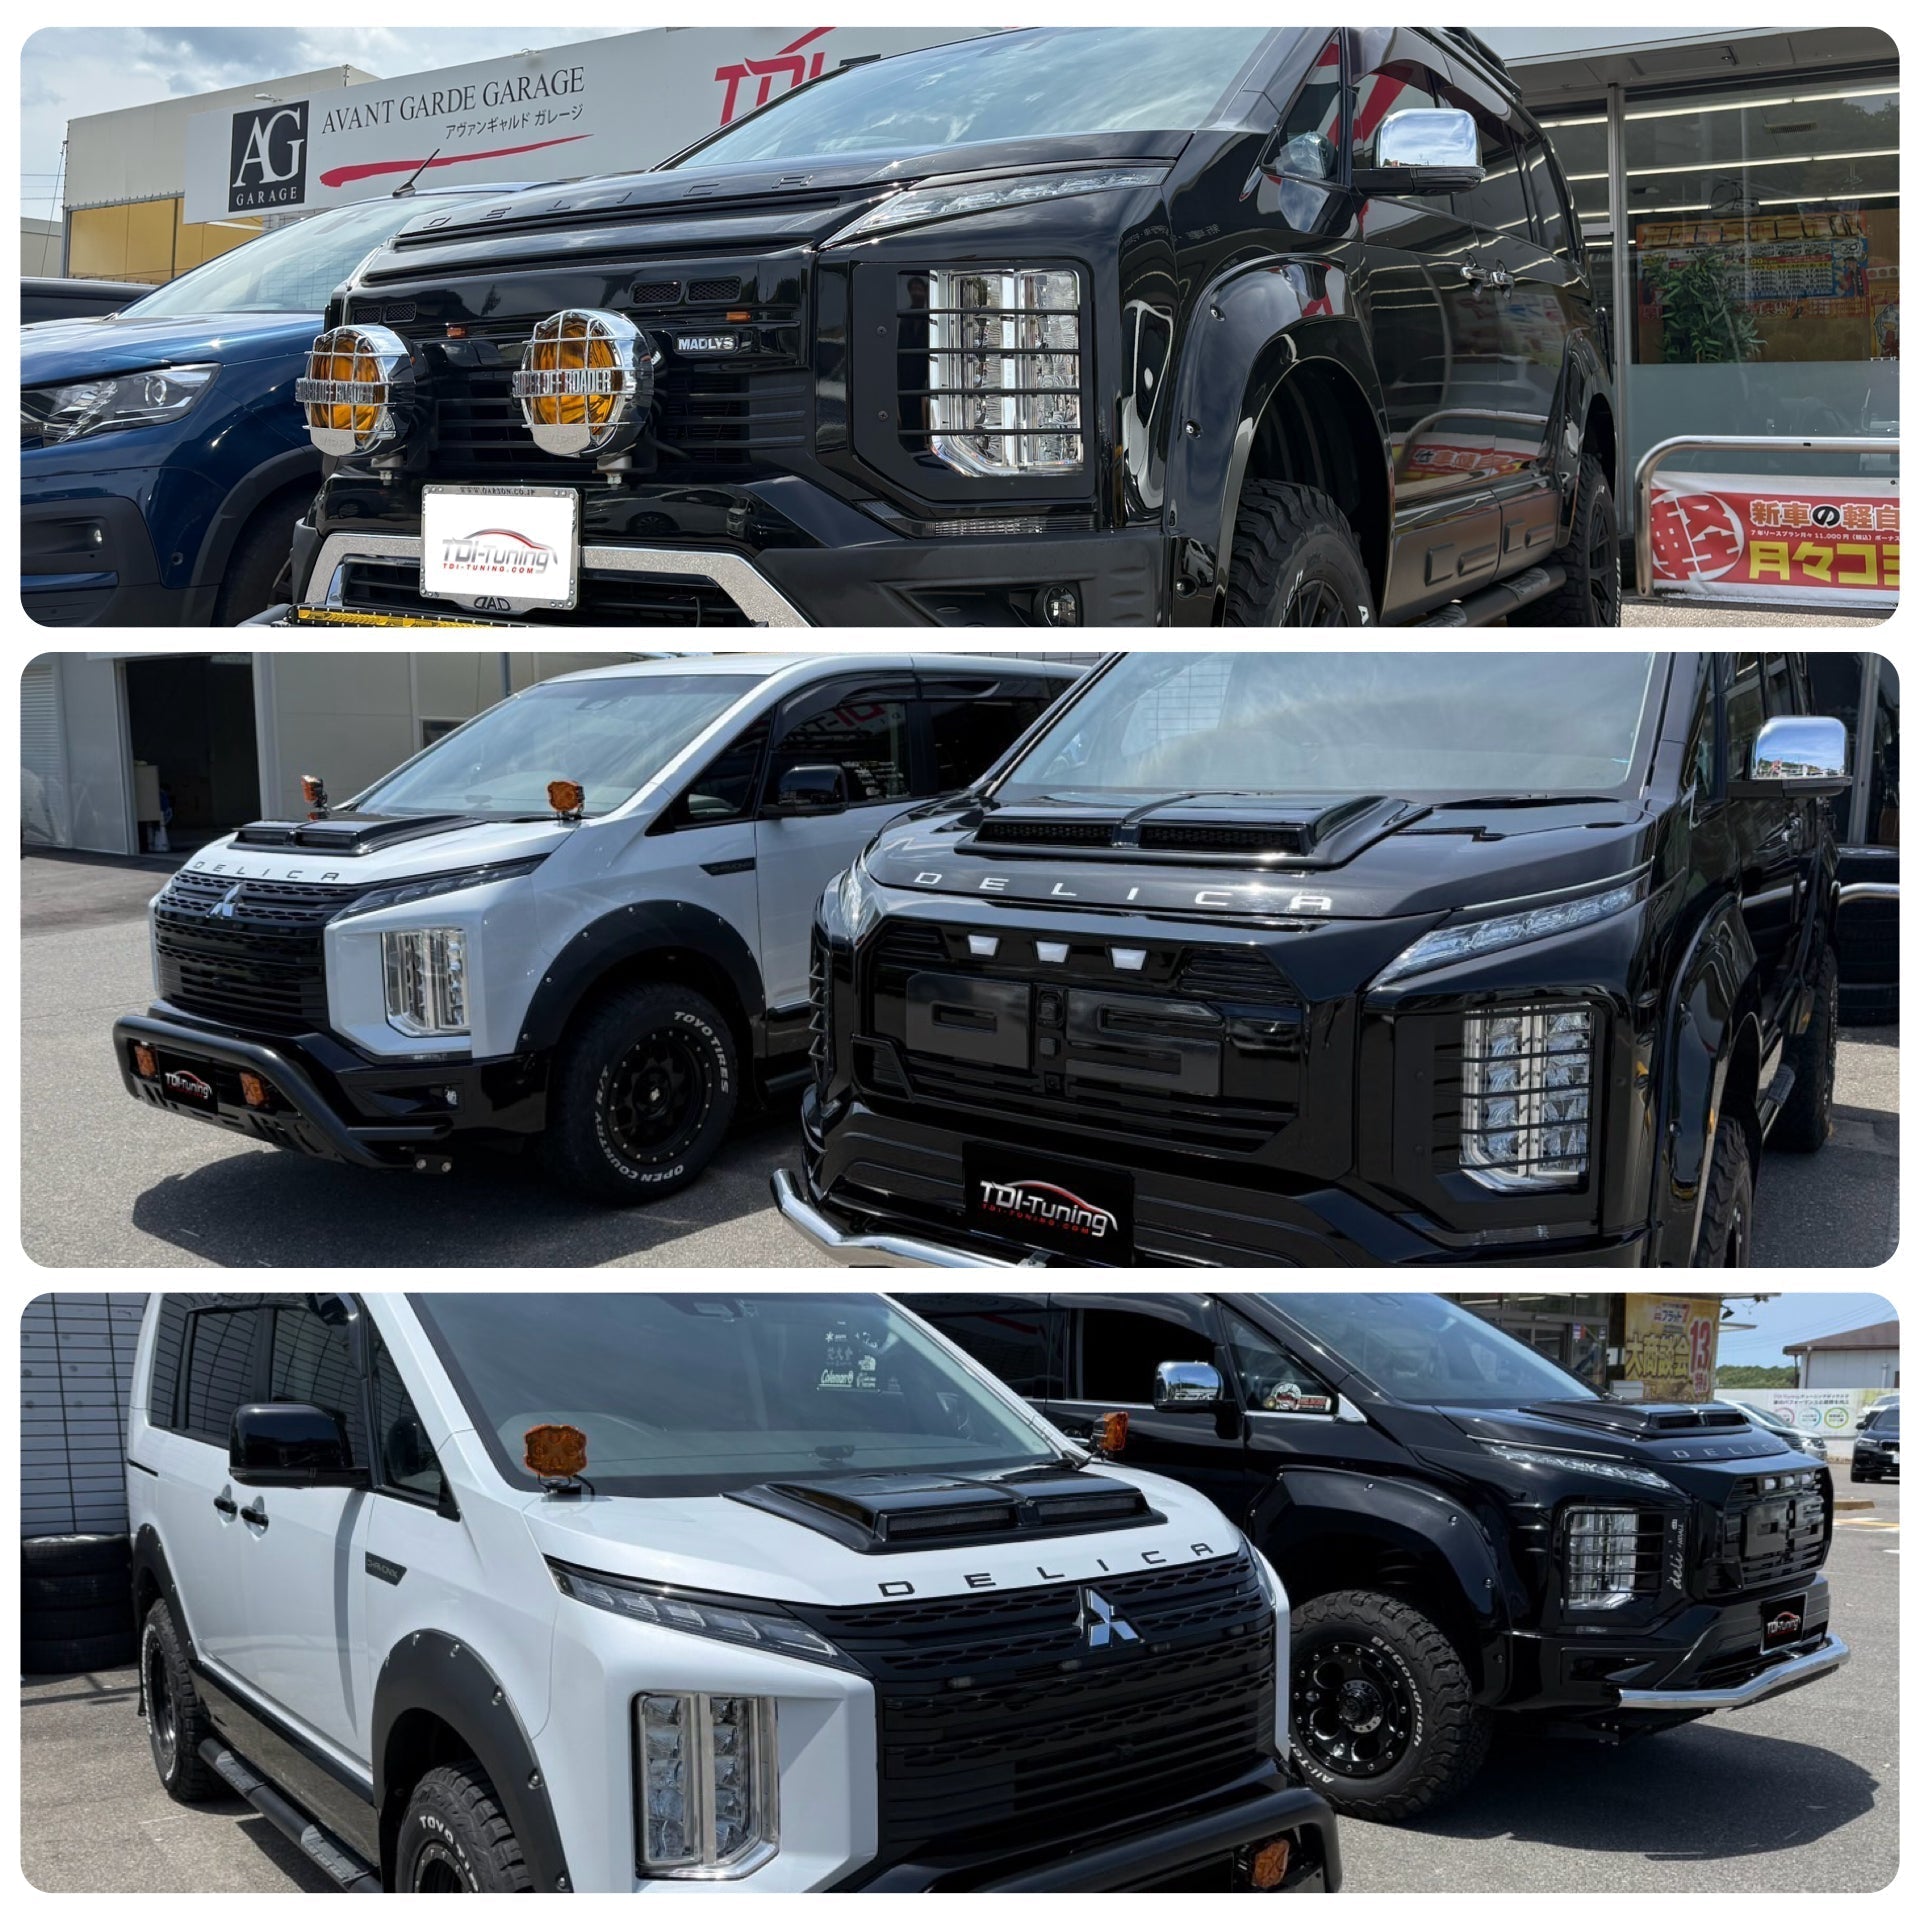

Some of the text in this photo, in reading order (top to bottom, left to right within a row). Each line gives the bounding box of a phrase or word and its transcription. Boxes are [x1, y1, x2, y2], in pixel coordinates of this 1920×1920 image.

[321, 66, 586, 134] AVANT GARDE GARAGE
[446, 103, 584, 140] アヴァンギャルド ガレージ
[232, 106, 305, 188] AG
[236, 186, 298, 207] GARAGE
[678, 337, 735, 350] MADLYS
[564, 369, 612, 394] ROADER
[192, 860, 340, 881] DELICA
[913, 871, 1332, 910] DELICA
[674, 1011, 729, 1094] TOYO TIRES
[640, 1164, 684, 1182] OPEN
[878, 1542, 1214, 1597] DELICA
[419, 1815, 454, 1845] TOYO
